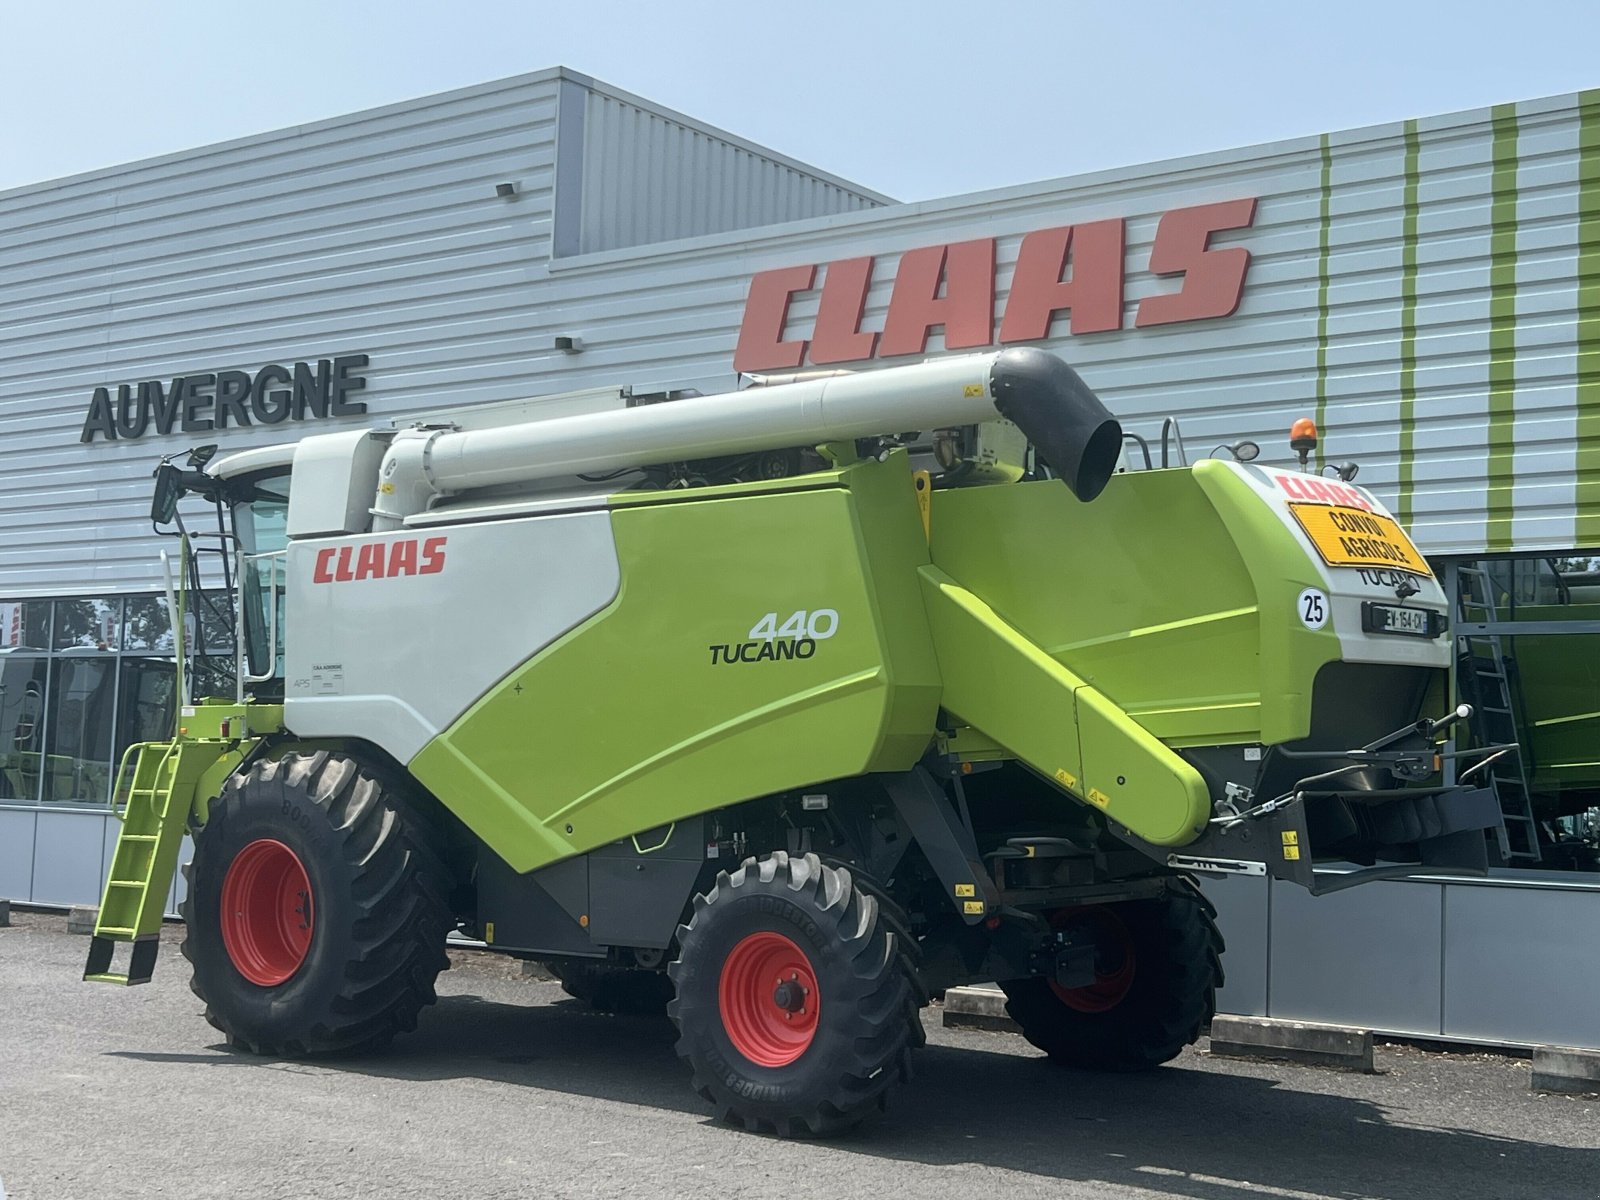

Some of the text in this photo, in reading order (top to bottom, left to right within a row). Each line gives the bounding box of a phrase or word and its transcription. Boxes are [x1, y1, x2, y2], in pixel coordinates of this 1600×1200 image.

[733, 197, 1258, 373] CLAAS
[80, 354, 369, 443] AUVERGNE
[1275, 476, 1374, 512] CLAAS
[1329, 511, 1387, 538] CONVOI
[313, 536, 448, 584] CLAAS
[1339, 536, 1411, 564] AGRICOLE
[749, 608, 839, 642] 440
[1304, 595, 1323, 622] 25
[709, 638, 816, 665] TUCANO
